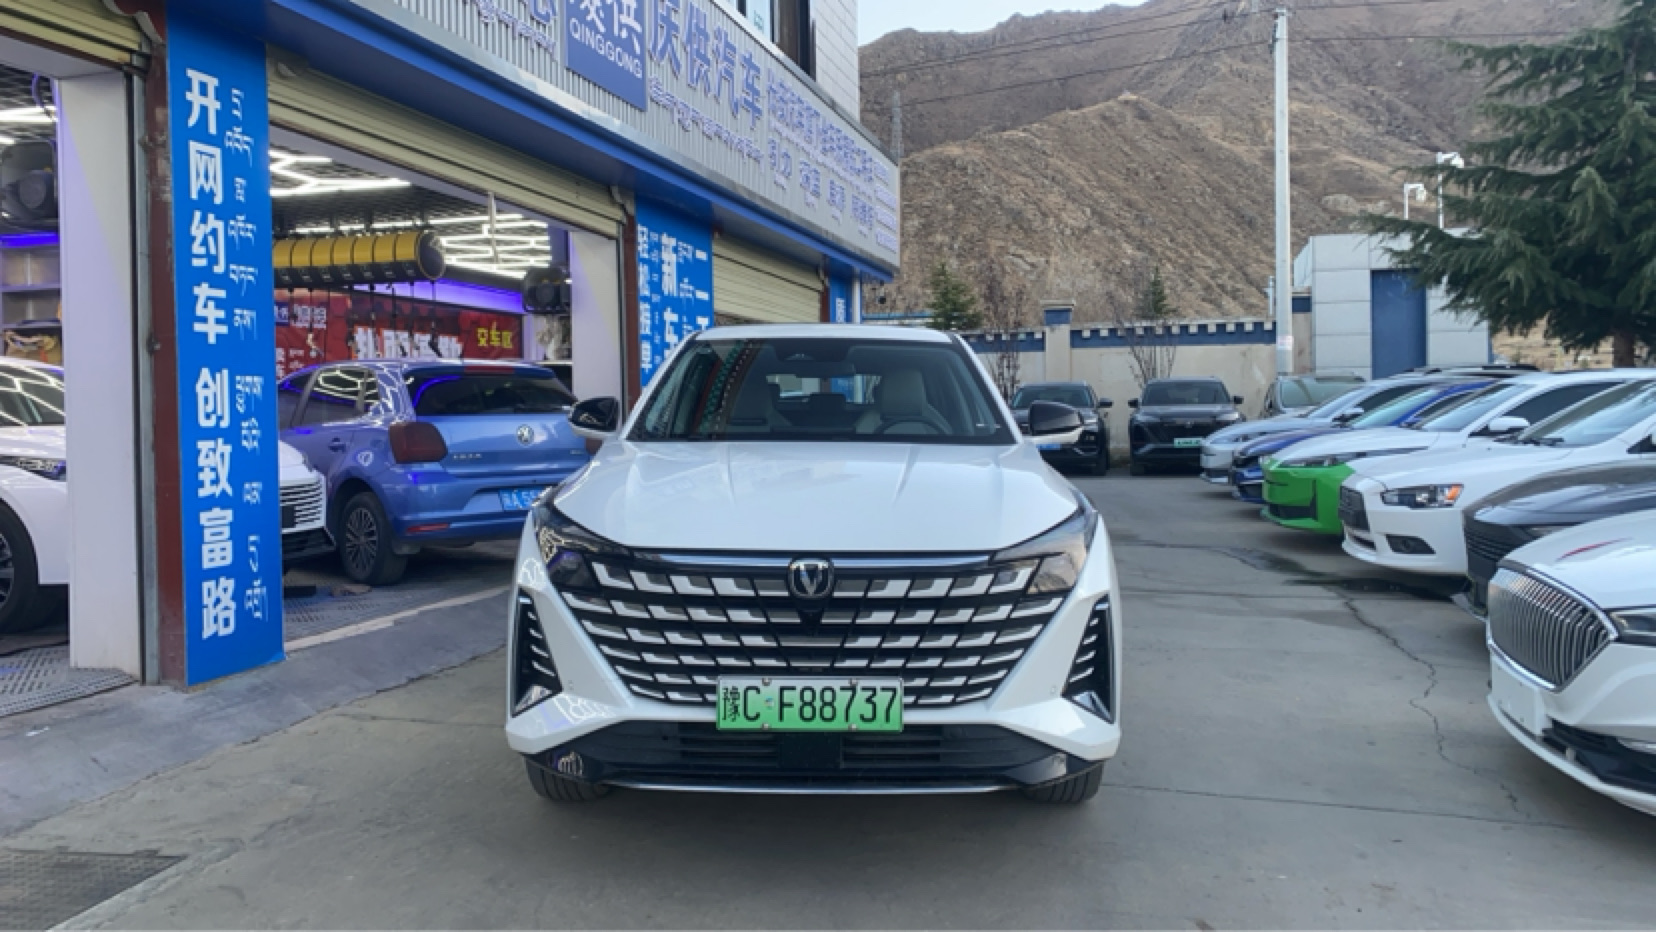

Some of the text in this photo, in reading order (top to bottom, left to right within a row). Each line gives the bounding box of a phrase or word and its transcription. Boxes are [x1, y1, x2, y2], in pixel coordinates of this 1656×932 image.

[570, 18, 643, 79] QINGGONG
[185, 67, 236, 639] 开网约车 创致富路
